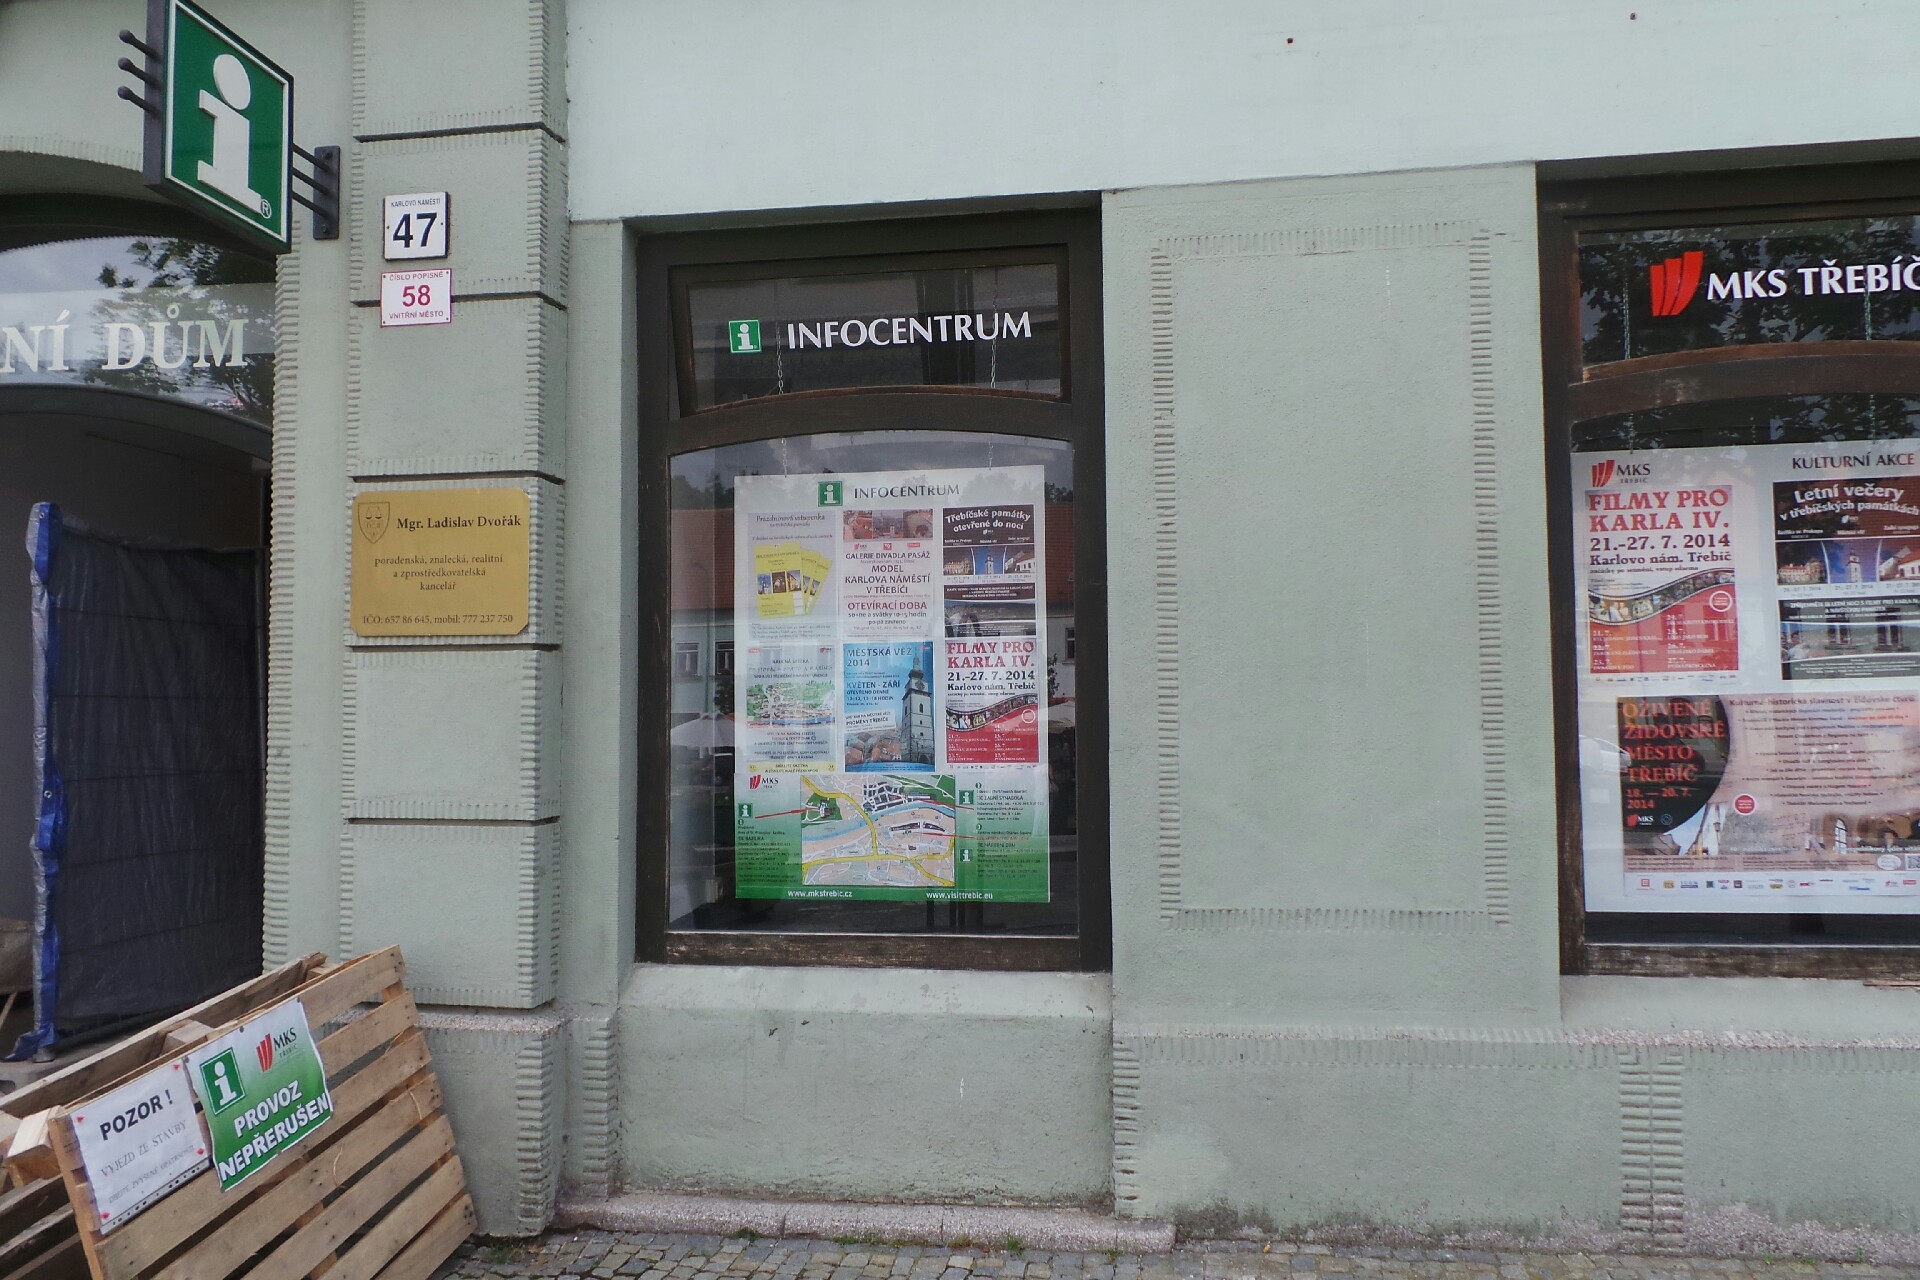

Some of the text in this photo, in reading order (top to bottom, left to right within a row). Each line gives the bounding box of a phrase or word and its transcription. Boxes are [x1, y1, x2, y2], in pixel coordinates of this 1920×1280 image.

[391, 199, 416, 208] KARLOVO
[392, 211, 438, 248] 47
[389, 269, 444, 281] ČÍSLO POPISNÉ
[1707, 269, 1787, 300] MKS
[402, 284, 431, 308] 58
[389, 309, 444, 320] VNITŘNÍ MĚSTO
[101, 303, 249, 371] DŮM
[787, 311, 1032, 350] INFOCENTRUM
[1792, 452, 1915, 469] KULTURNÍ AKCE
[1616, 463, 1651, 476] MKS
[854, 483, 960, 499] INFOCENTRUM
[1794, 482, 1905, 504] Letní večery
[1589, 488, 1729, 511] FILMY PRO
[945, 509, 1031, 524] Třebíčské památky
[1779, 500, 1919, 521] v třebíčských památkách
[396, 514, 521, 532] Mgr. Ladislav Dvořák
[953, 519, 1025, 533] otevřené do noci
[1589, 510, 1729, 533] KARLA IV.
[1661, 535, 1677, 549] 7.
[1683, 533, 1731, 549] 2014
[374, 553, 504, 567] poradenská, znalecká, realitní
[845, 550, 931, 560] GALERIE DIVADLA PASÁŽ
[1590, 551, 1732, 566] Karlovo nám. Třebíč
[400, 567, 486, 580] zprostředkovatelská
[871, 564, 904, 573] MODEL
[845, 572, 931, 584] KARLOVA NÁMĚSTÍ
[420, 581, 457, 591] kancelář
[866, 584, 909, 594] V TŘEBÍČI
[847, 599, 928, 610] OTEVÍRACÍ DOBA
[363, 613, 513, 625] IČO: 657 86 645, mobil: 777 237 750
[872, 611, 893, 619] svátky
[847, 647, 891, 657] MĚSTSKÁ
[947, 640, 1035, 655] FILMY PRO
[847, 658, 871, 667] 2014
[947, 654, 1035, 669] KARLA IV.
[991, 671, 1002, 681] 7.
[1005, 670, 1036, 681] 2014
[846, 681, 876, 689] KVĚTEN
[882, 679, 901, 688] ZÁŘÍ
[947, 681, 1036, 691] Karlovo nám. Třebíč
[1622, 700, 1712, 718] OŽIVENÉ
[1623, 720, 1726, 740] ŽIDOVSKÉ
[1625, 741, 1695, 761] MĚSTO
[1626, 764, 1698, 782] TŘEBÍČ
[761, 777, 779, 785] MKS
[1626, 788, 1643, 798] 18.
[1681, 787, 1692, 797] 7.
[1627, 798, 1655, 809] 2014
[1637, 815, 1654, 823] MKS
[787, 889, 853, 899] www.mkstrebic.cz
[926, 890, 994, 900] www.visittrebic.eu
[273, 1027, 297, 1051] MKS
[99, 1089, 173, 1141] POZOR !
[233, 1079, 303, 1138] PROVOZ
[138, 1142, 151, 1156] ZE
[151, 1119, 187, 1147] STAVBY
[218, 1092, 330, 1182] NEPŘERUŠEN
